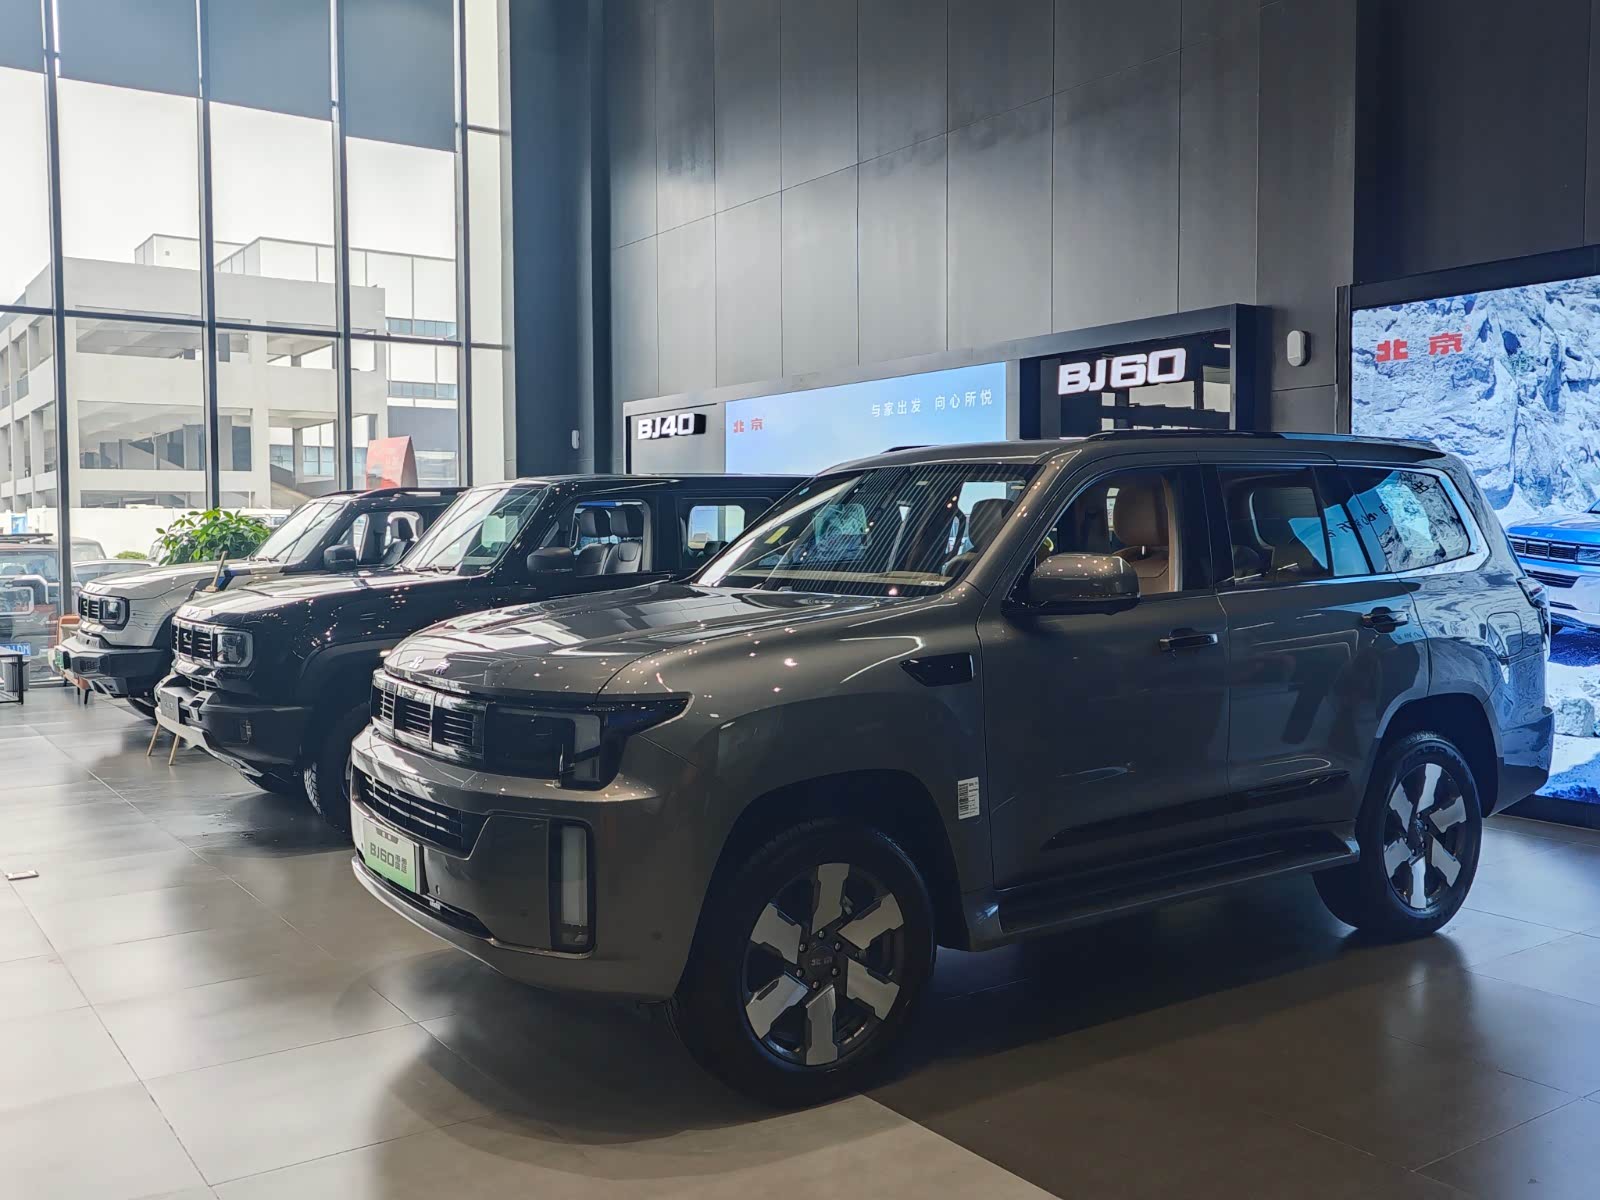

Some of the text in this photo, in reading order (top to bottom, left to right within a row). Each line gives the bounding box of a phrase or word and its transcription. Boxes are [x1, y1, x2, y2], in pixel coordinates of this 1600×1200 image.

[1376, 333, 1463, 362] 北京
[1058, 348, 1186, 395] BJ60
[871, 388, 993, 418] 与家出发 向心所悦
[638, 412, 695, 440] BJ40
[733, 418, 764, 433] 北京
